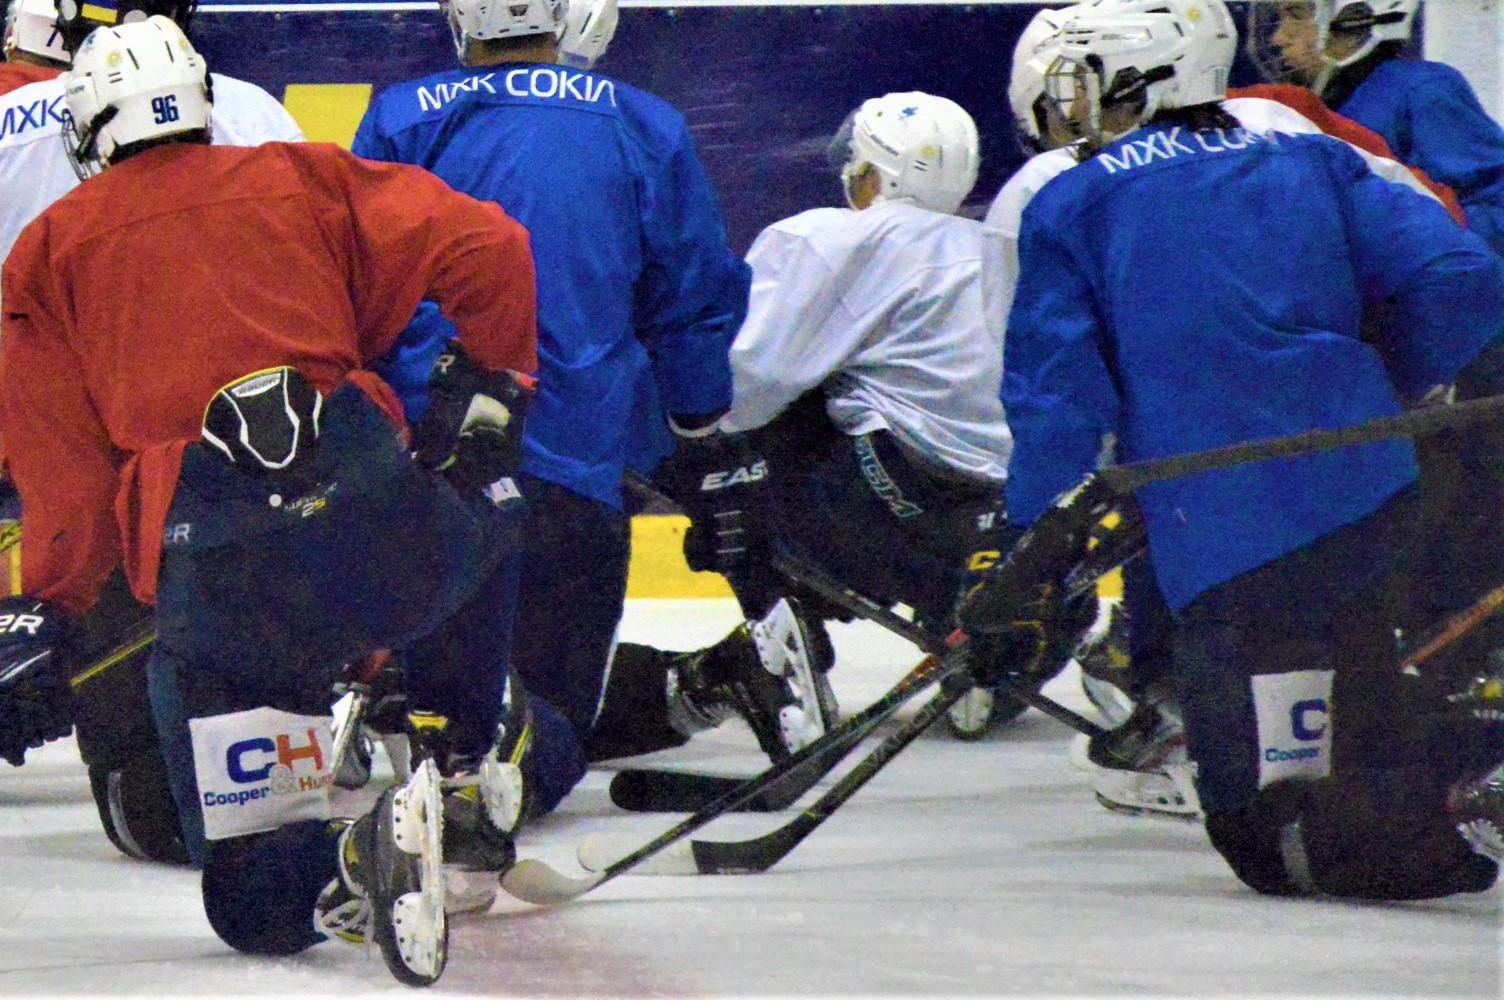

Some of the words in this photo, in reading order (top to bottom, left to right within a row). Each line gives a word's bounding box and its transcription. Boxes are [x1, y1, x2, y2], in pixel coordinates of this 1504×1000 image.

[152, 94, 180, 125] 96
[226, 728, 323, 784] CH
[204, 786, 270, 806] Cooper
